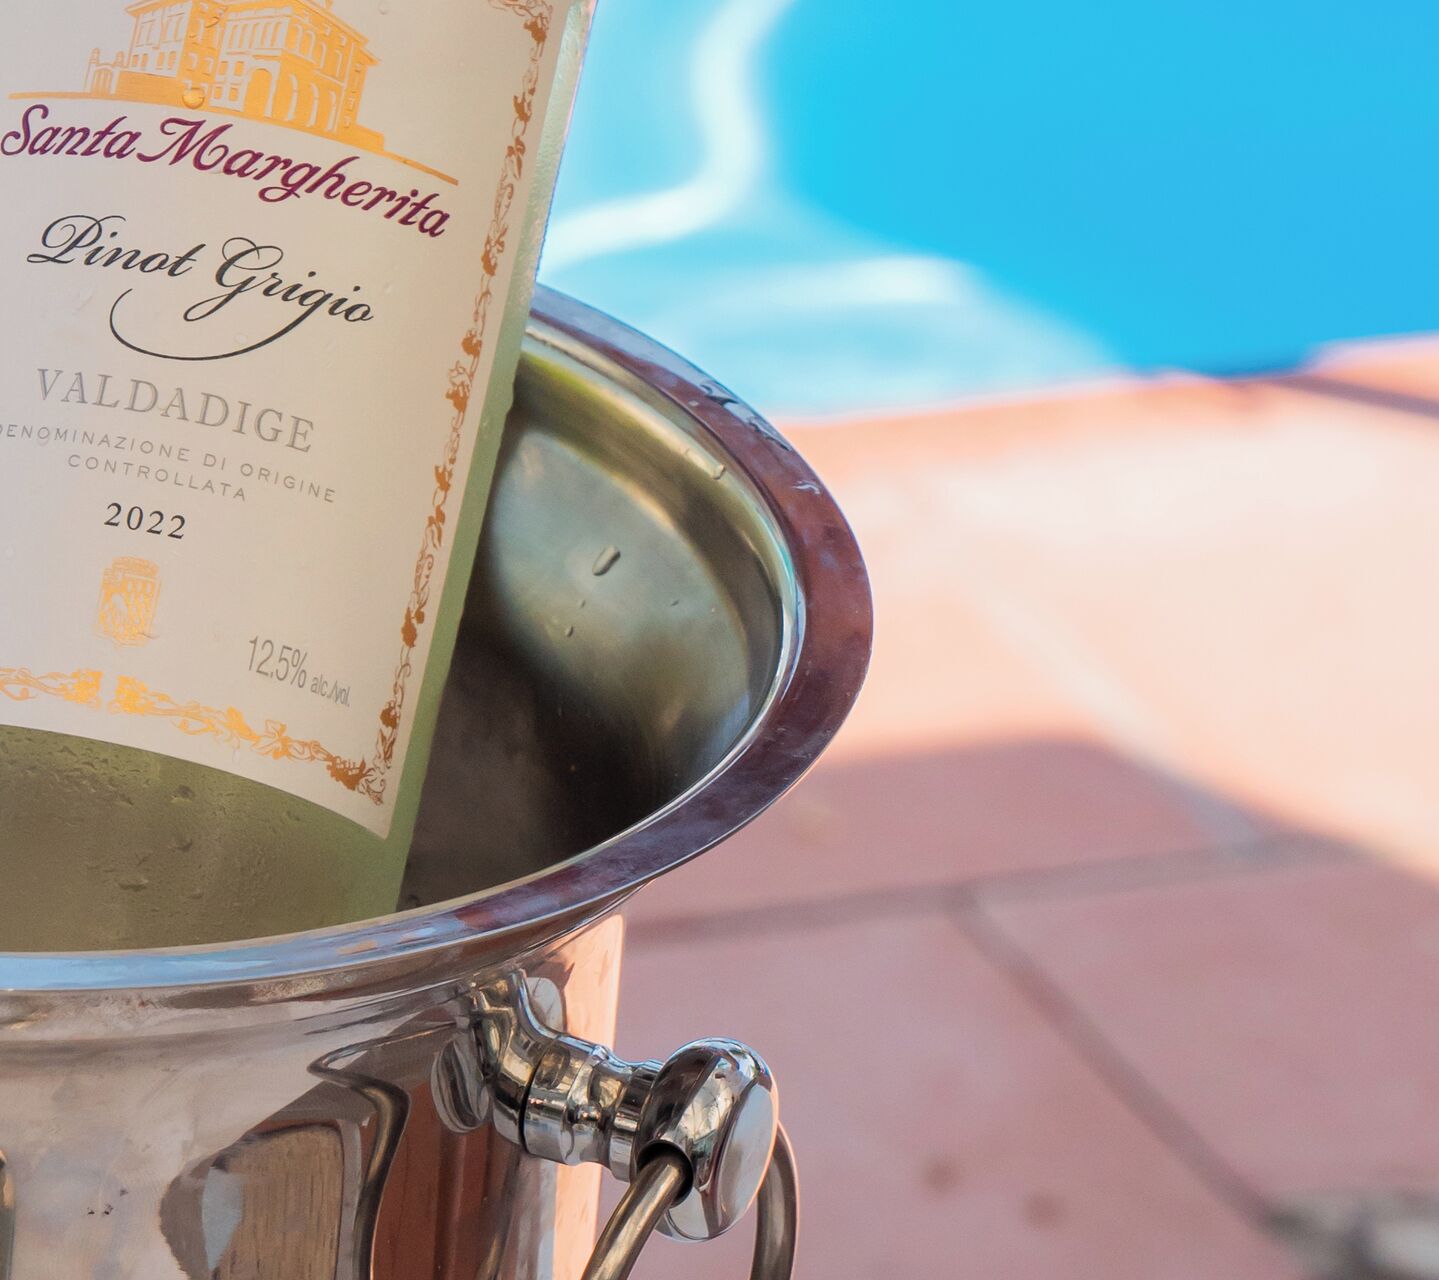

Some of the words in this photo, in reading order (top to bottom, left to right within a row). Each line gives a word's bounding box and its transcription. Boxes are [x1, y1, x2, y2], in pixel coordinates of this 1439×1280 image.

[0, 104, 140, 159] Santa
[137, 116, 451, 239] Margherita
[26, 214, 206, 278] Pinot
[109, 237, 375, 361] Grigio
[36, 368, 315, 453] VALDADIGE
[67, 454, 246, 502] CONTROLLATA
[203, 454, 226, 471] DI
[240, 462, 336, 503] ORIGINE
[103, 502, 187, 540] 2022
